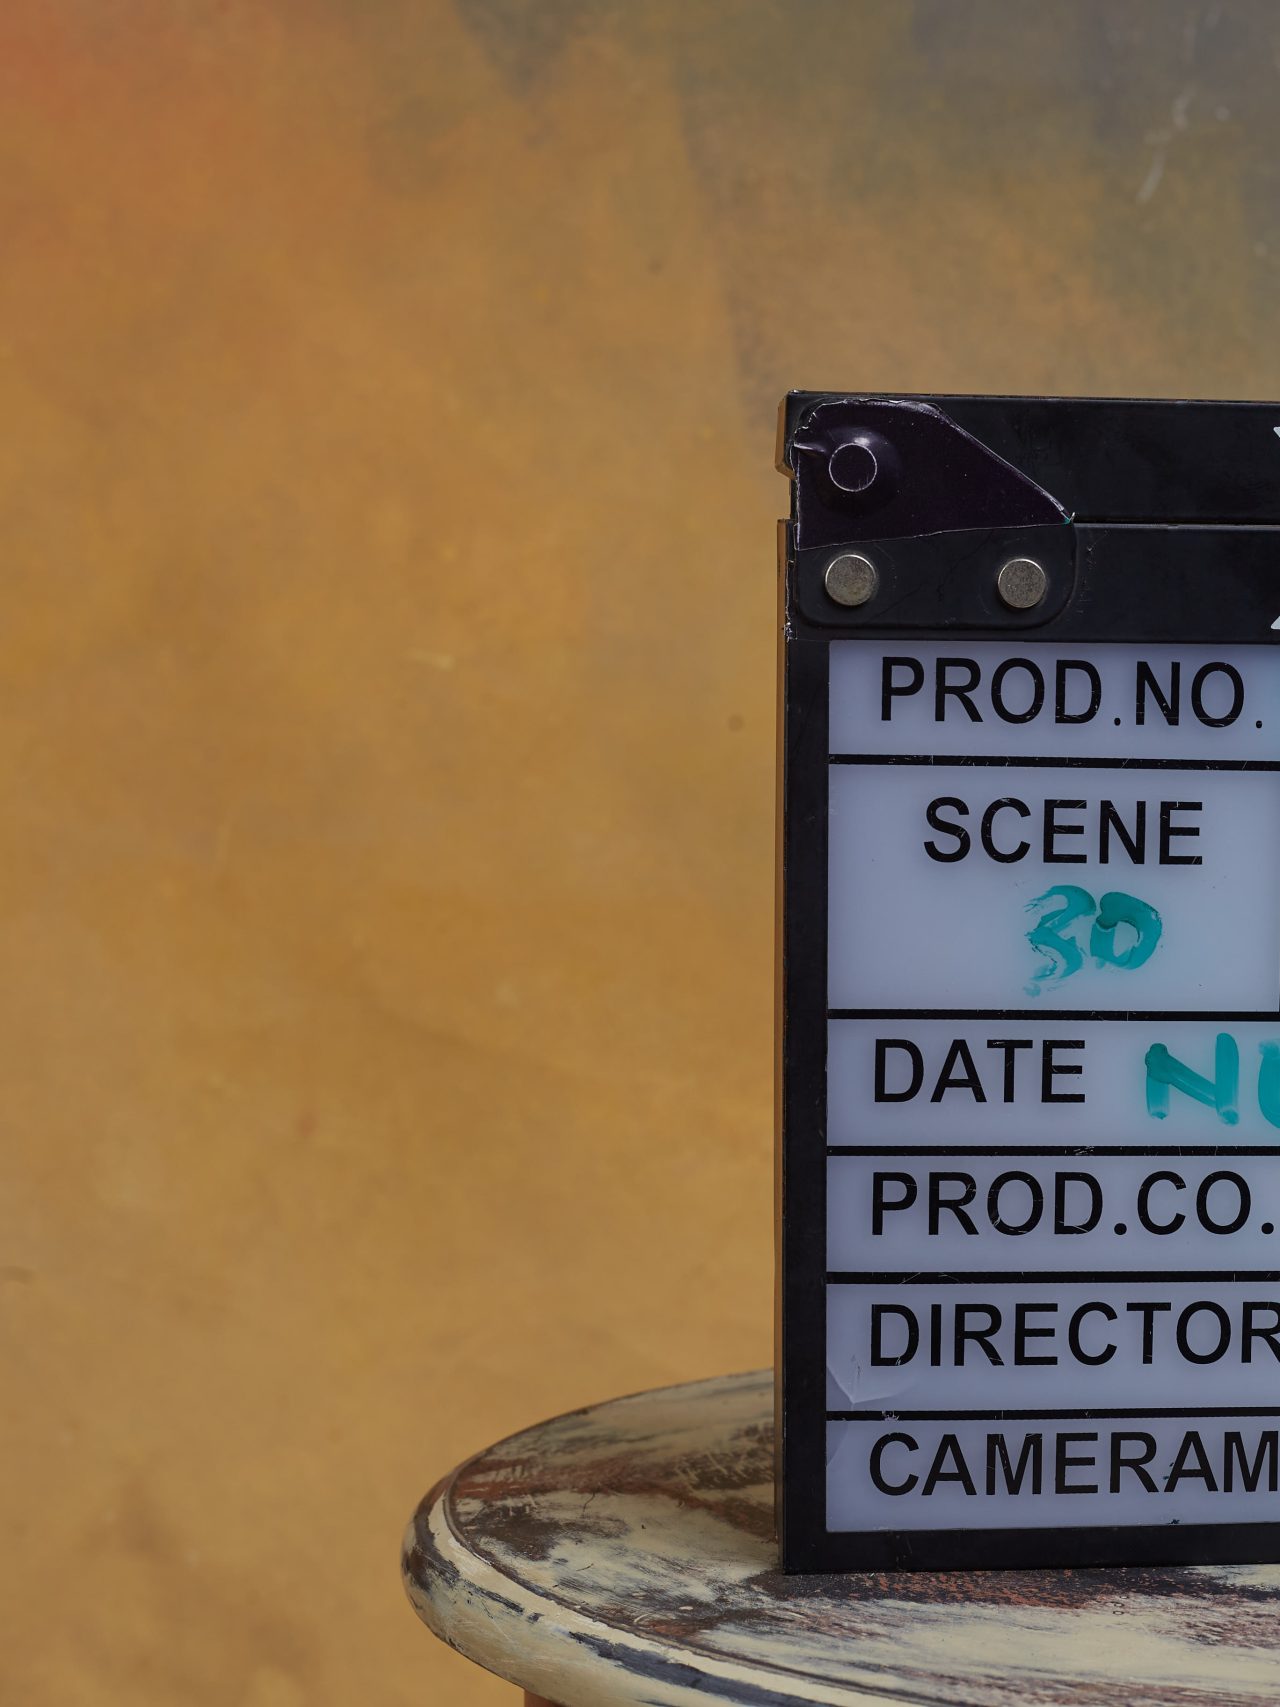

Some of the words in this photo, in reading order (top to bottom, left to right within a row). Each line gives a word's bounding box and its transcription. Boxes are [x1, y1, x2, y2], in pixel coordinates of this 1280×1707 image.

[880, 656, 1264, 729] PROD.NO.
[923, 796, 1204, 864] SCENE
[1024, 884, 1163, 997] 30
[873, 1038, 1087, 1104] DATE
[870, 1169, 1276, 1237] PROD.CO.
